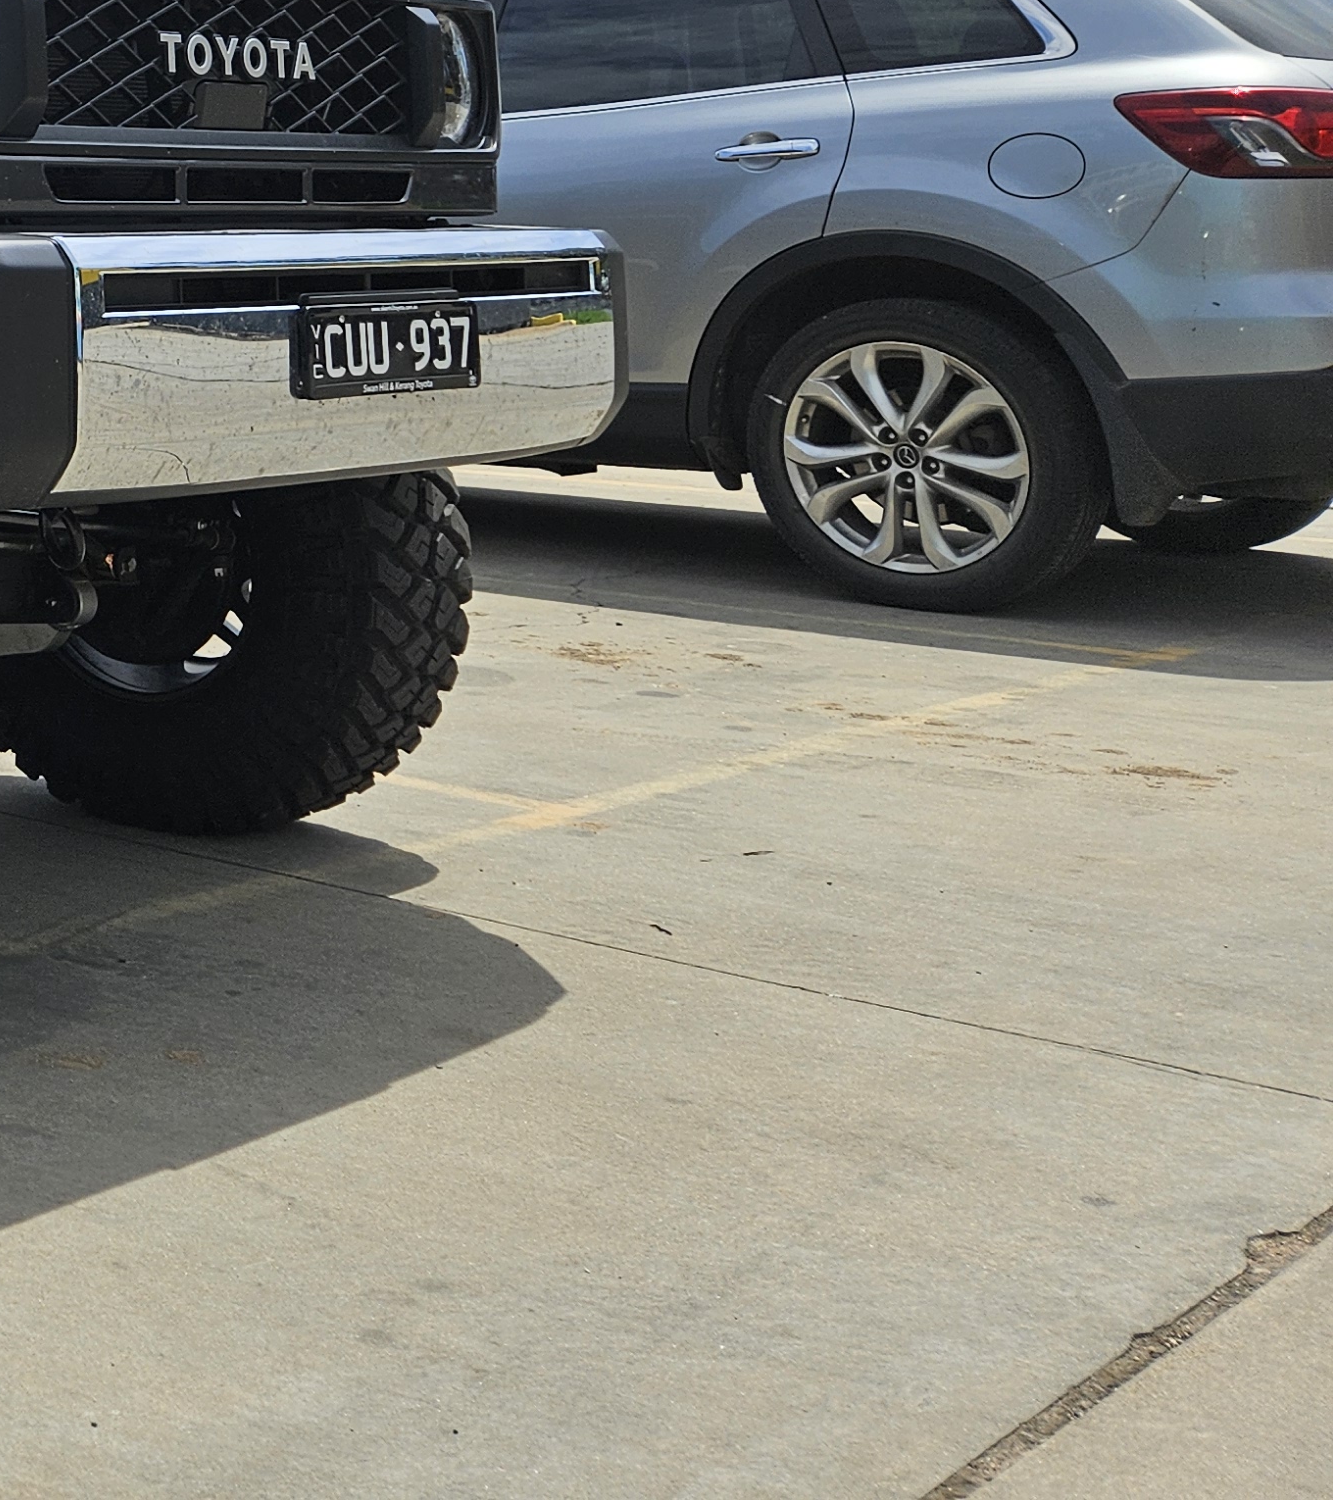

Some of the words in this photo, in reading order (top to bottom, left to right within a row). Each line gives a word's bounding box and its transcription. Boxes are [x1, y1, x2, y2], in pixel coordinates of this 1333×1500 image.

[158, 31, 317, 81] TOYOTA
[378, 382, 389, 392] Hill
[415, 380, 434, 390] Toyota
